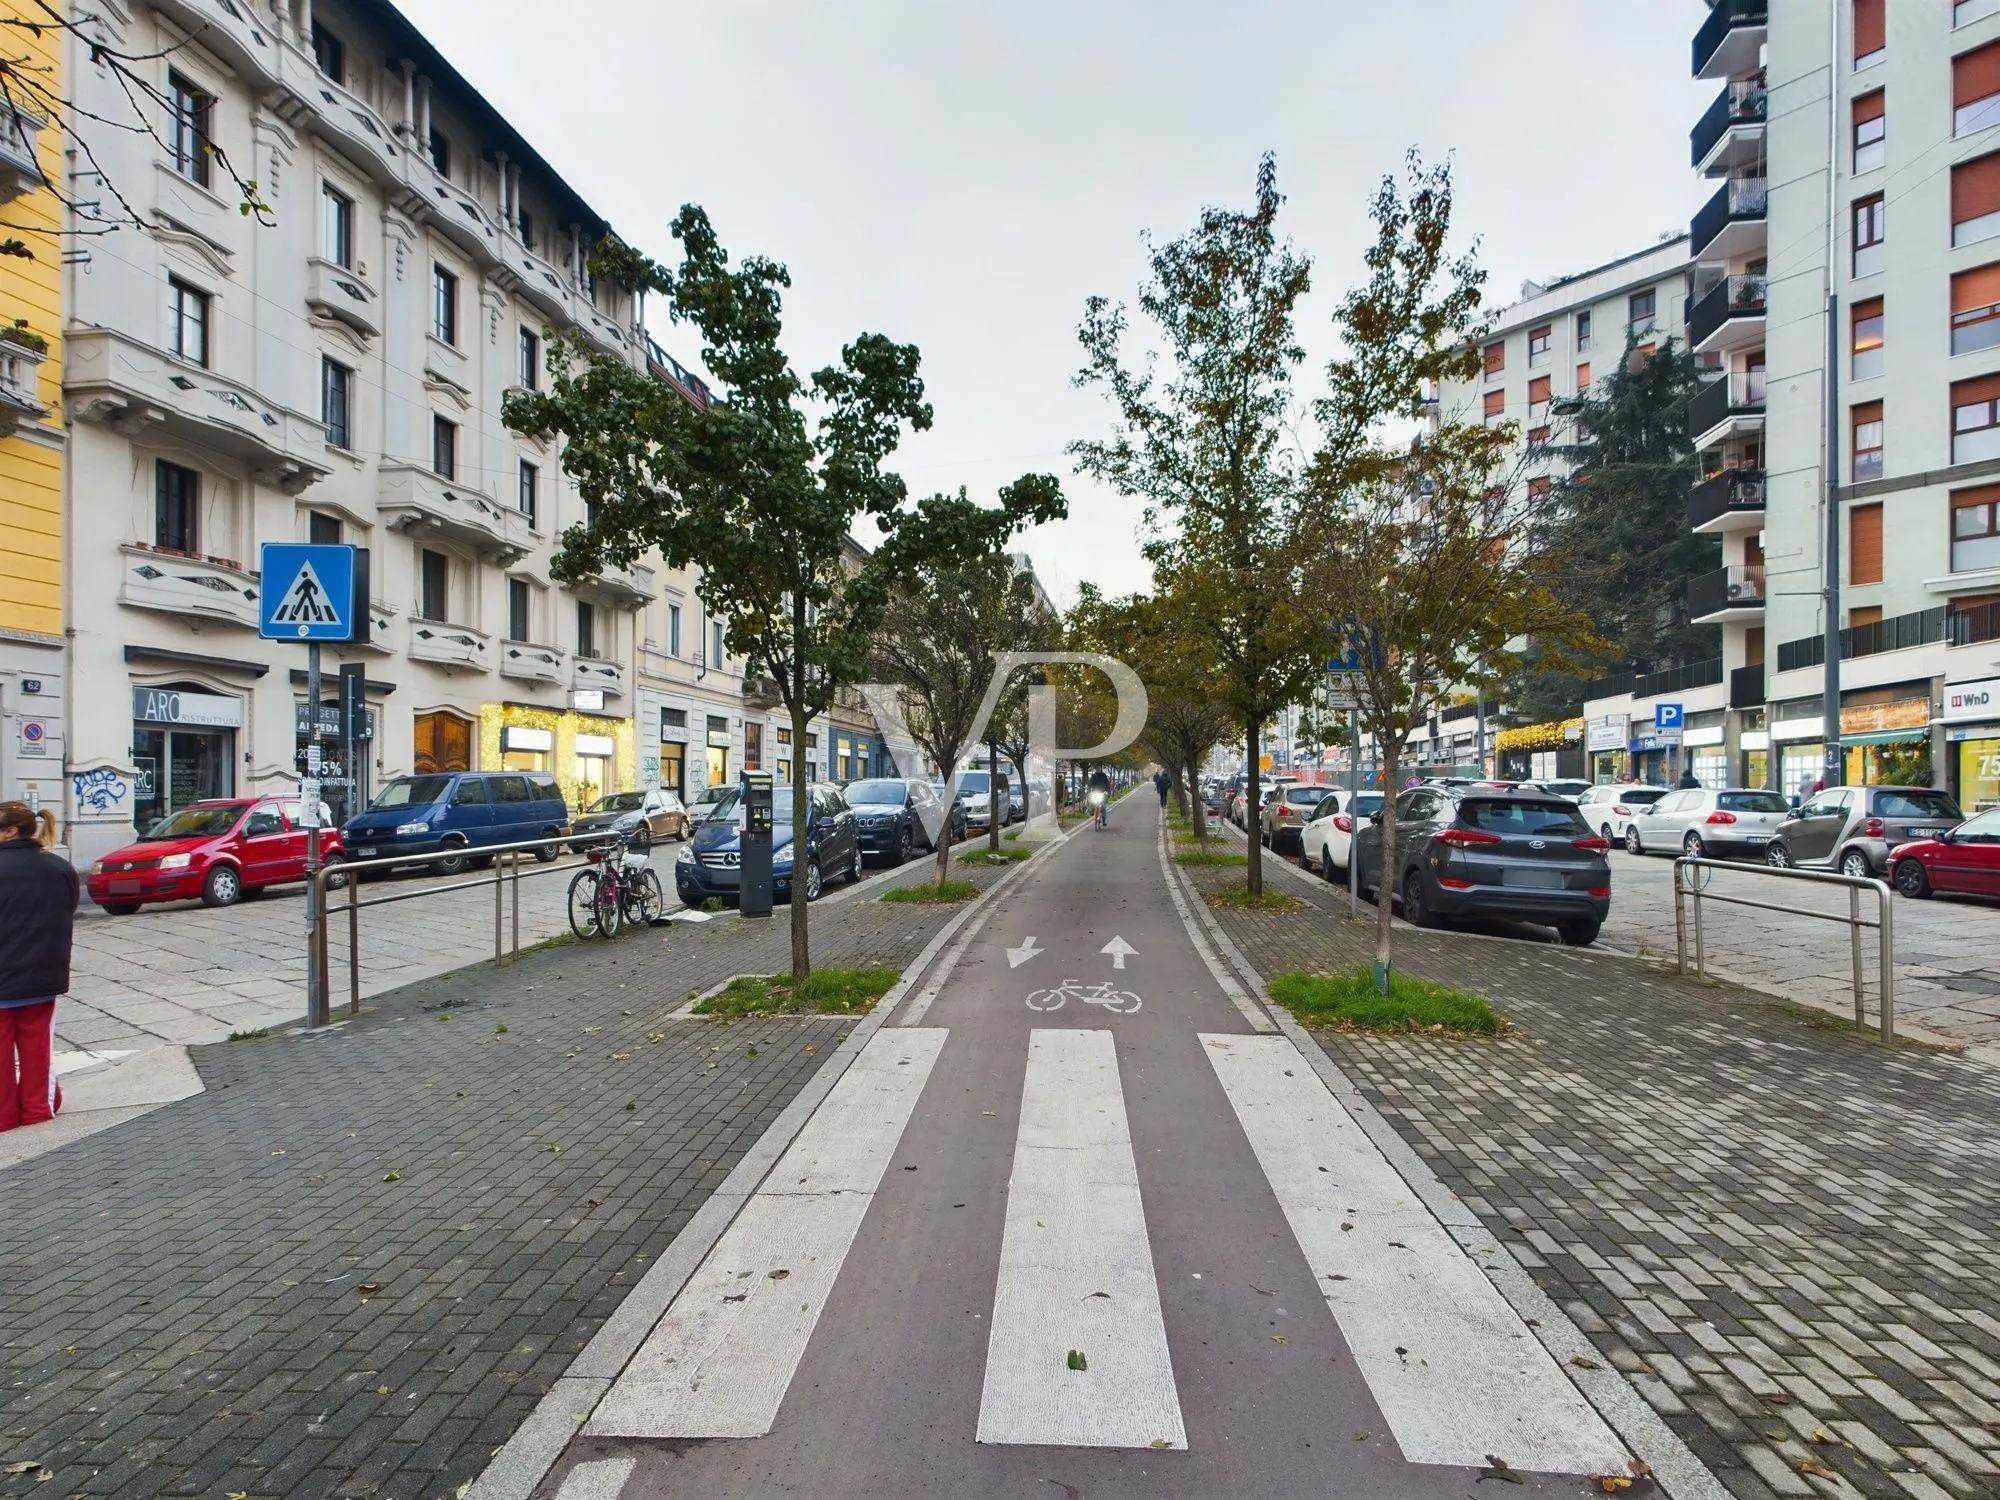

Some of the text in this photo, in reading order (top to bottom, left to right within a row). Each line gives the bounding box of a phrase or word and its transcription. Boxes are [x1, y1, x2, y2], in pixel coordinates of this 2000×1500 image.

[28, 682, 40, 690] 62
[144, 691, 181, 721] ARC
[1964, 692, 1989, 706] WnD
[1661, 707, 1677, 725] P
